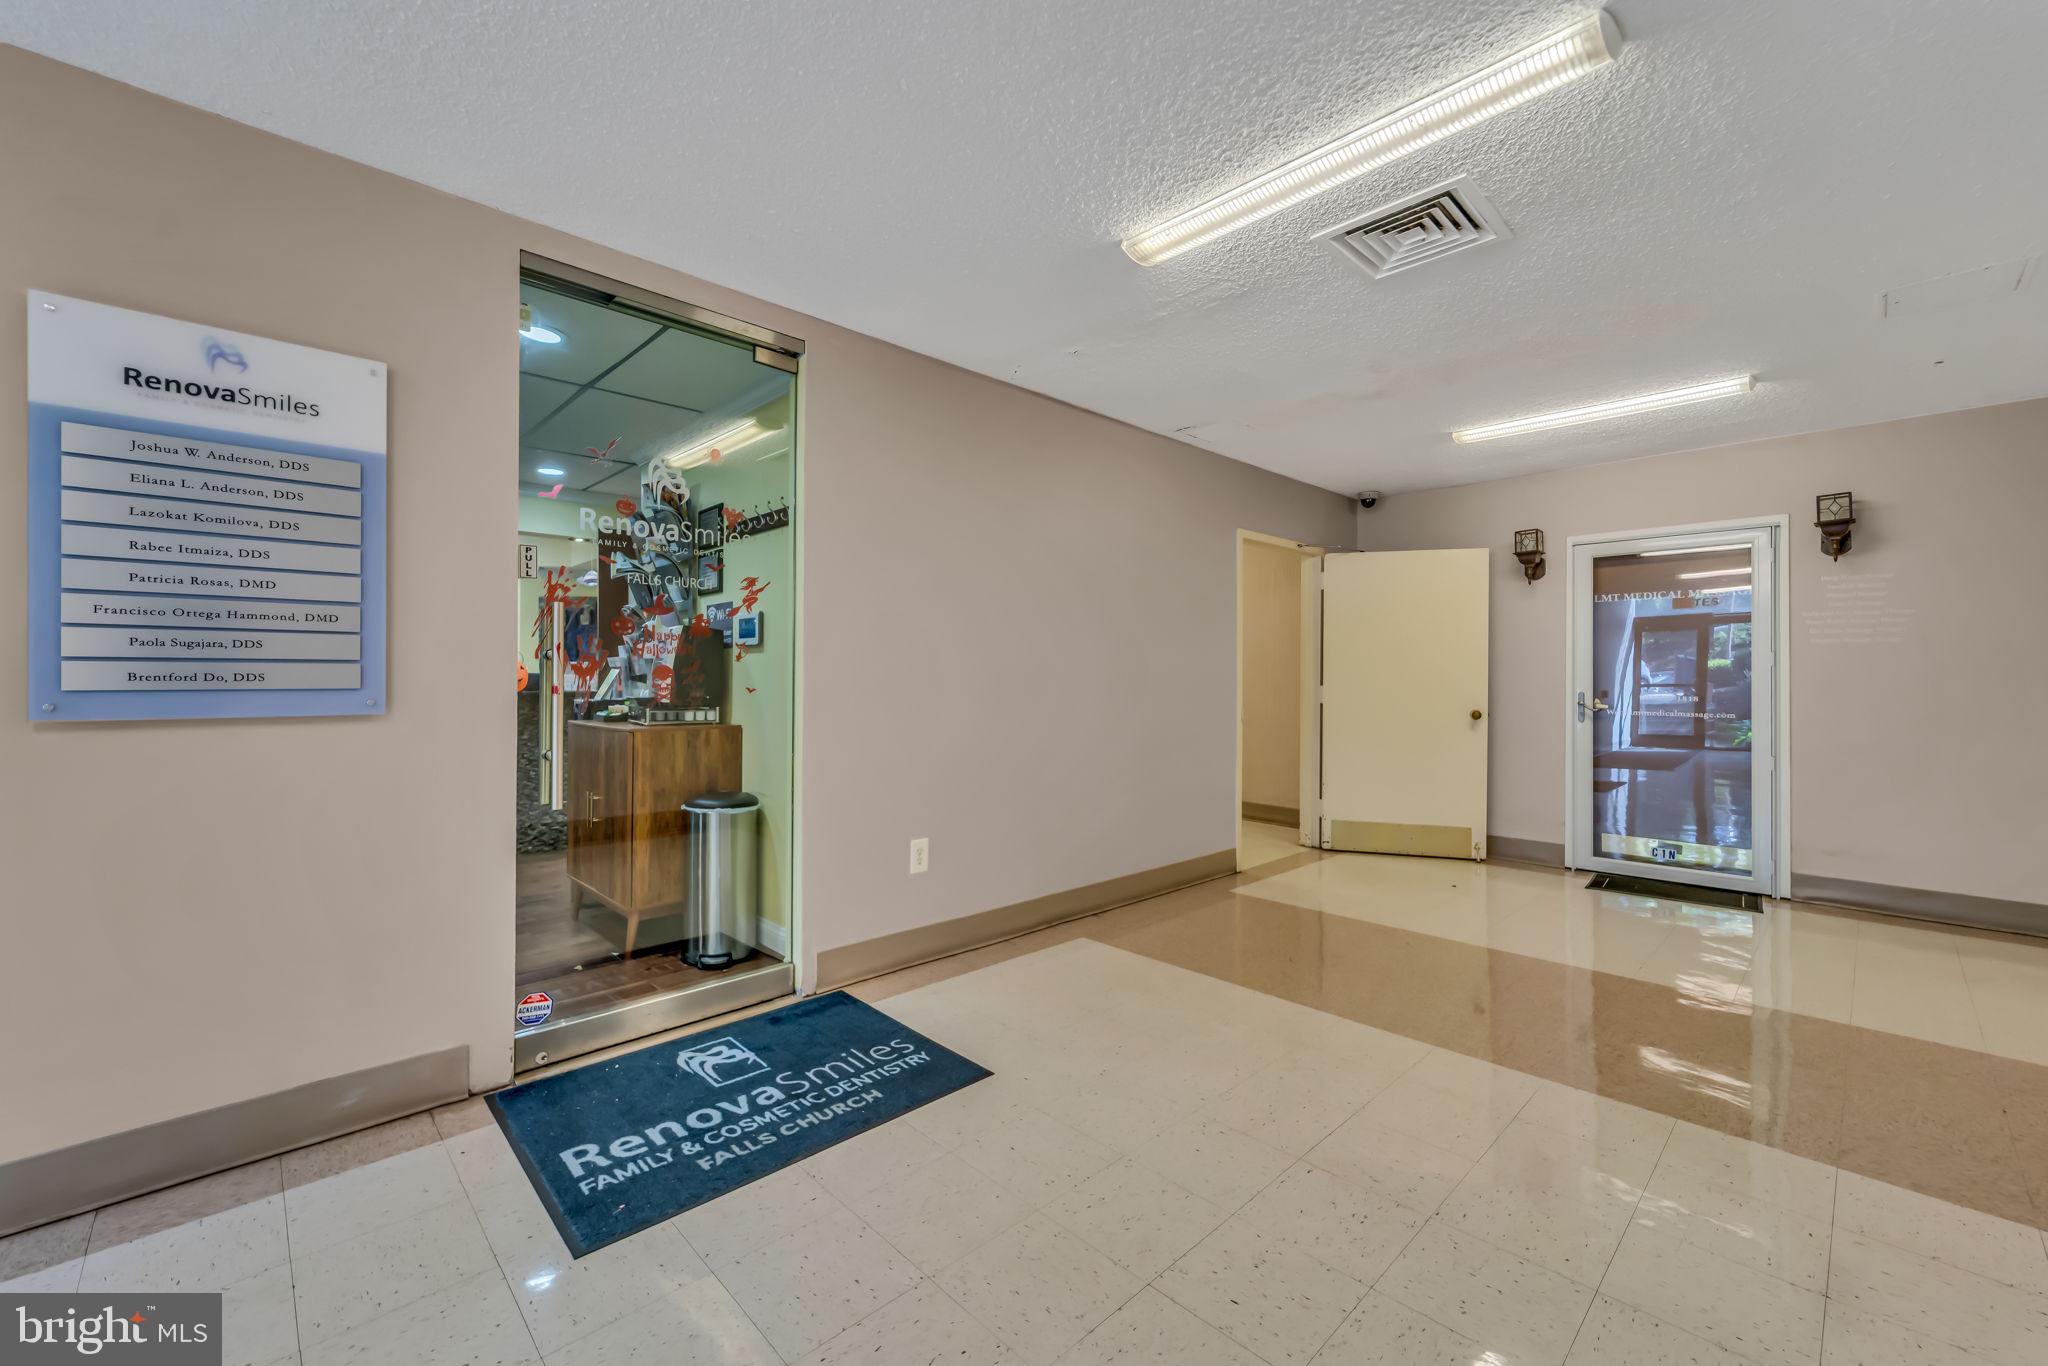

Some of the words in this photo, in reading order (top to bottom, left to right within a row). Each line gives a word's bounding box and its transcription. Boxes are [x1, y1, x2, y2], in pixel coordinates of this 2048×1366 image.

[122, 365, 321, 418] RenovaSmiles
[129, 440, 179, 455] Joshua
[184, 447, 200, 458] W.
[206, 450, 275, 469] Anderson,
[279, 460, 310, 472] DDS
[129, 473, 176, 487] Eliana
[181, 479, 195, 489] L.
[200, 481, 269, 499] Anderson,
[273, 490, 304, 502] DDS
[129, 506, 188, 521] Lazokat
[193, 512, 264, 529] Komilova,
[268, 520, 301, 532] DDS
[129, 540, 173, 553] Rabee
[178, 543, 234, 559] Itmaiza,
[238, 549, 271, 560] DDS
[128, 572, 184, 585] Patricia
[190, 576, 234, 589] Rosas,
[239, 579, 277, 590] DMD
[627, 573, 662, 586] FALLS
[664, 575, 713, 591] CHURCH
[1594, 593, 1620, 603] LMT
[1623, 590, 1685, 602] MEDICAL
[93, 604, 166, 617] Francisco
[172, 607, 221, 621] Ortega
[226, 610, 300, 623] Hammond,
[304, 613, 339, 623] DMD
[128, 637, 166, 648] Paola
[170, 638, 228, 651] Sugajara,
[232, 639, 263, 649] DDS
[127, 672, 198, 683] Brentford
[203, 673, 228, 684] Do,
[233, 673, 265, 683] DDS
[518, 1004, 550, 1014] ACKERMAN
[558, 1039, 915, 1178] RenovaSmiles
[578, 1148, 674, 1196] FAMILY
[681, 1141, 704, 1156] &
[704, 1092, 826, 1145] COSMETIC
[824, 1051, 931, 1098] DENTISTRY
[697, 1132, 778, 1171] FALLS
[780, 1089, 884, 1136] CHURCH
